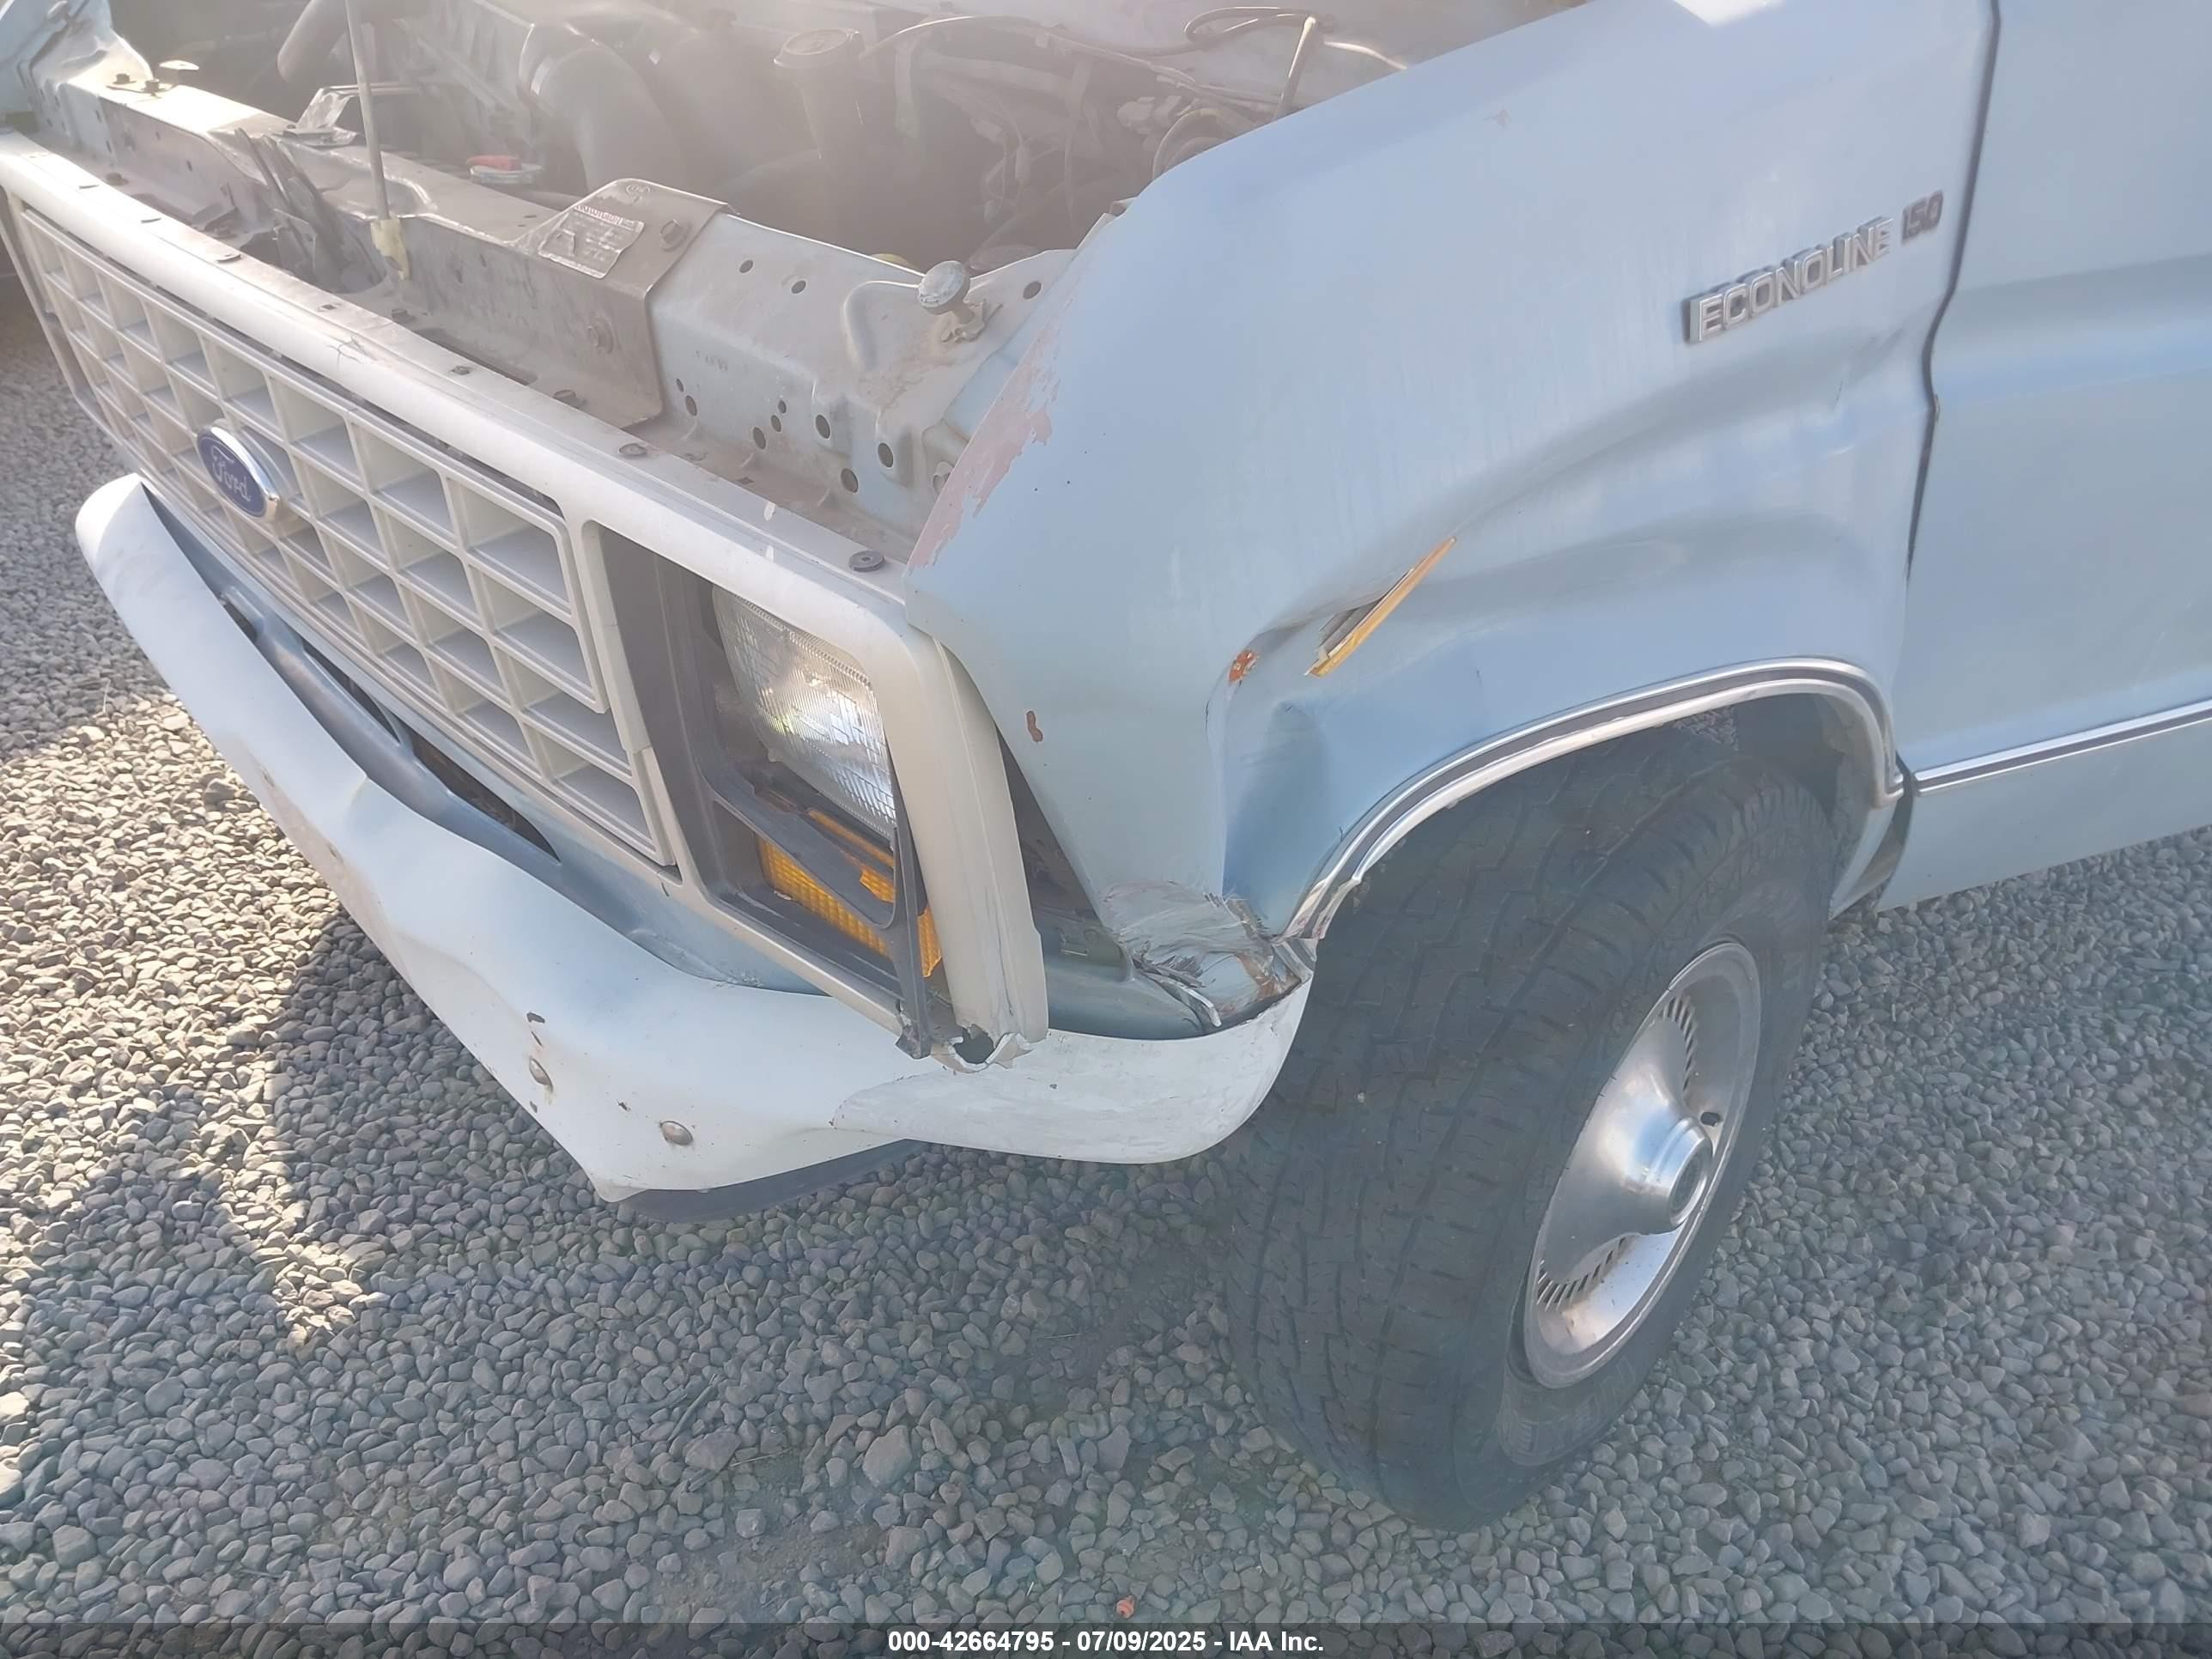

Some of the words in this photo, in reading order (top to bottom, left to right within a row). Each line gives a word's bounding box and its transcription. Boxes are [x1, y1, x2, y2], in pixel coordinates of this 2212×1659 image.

[1686, 216, 1894, 344] ECONOLINE
[1901, 191, 1944, 244] 150
[210, 446, 252, 503] Ford
